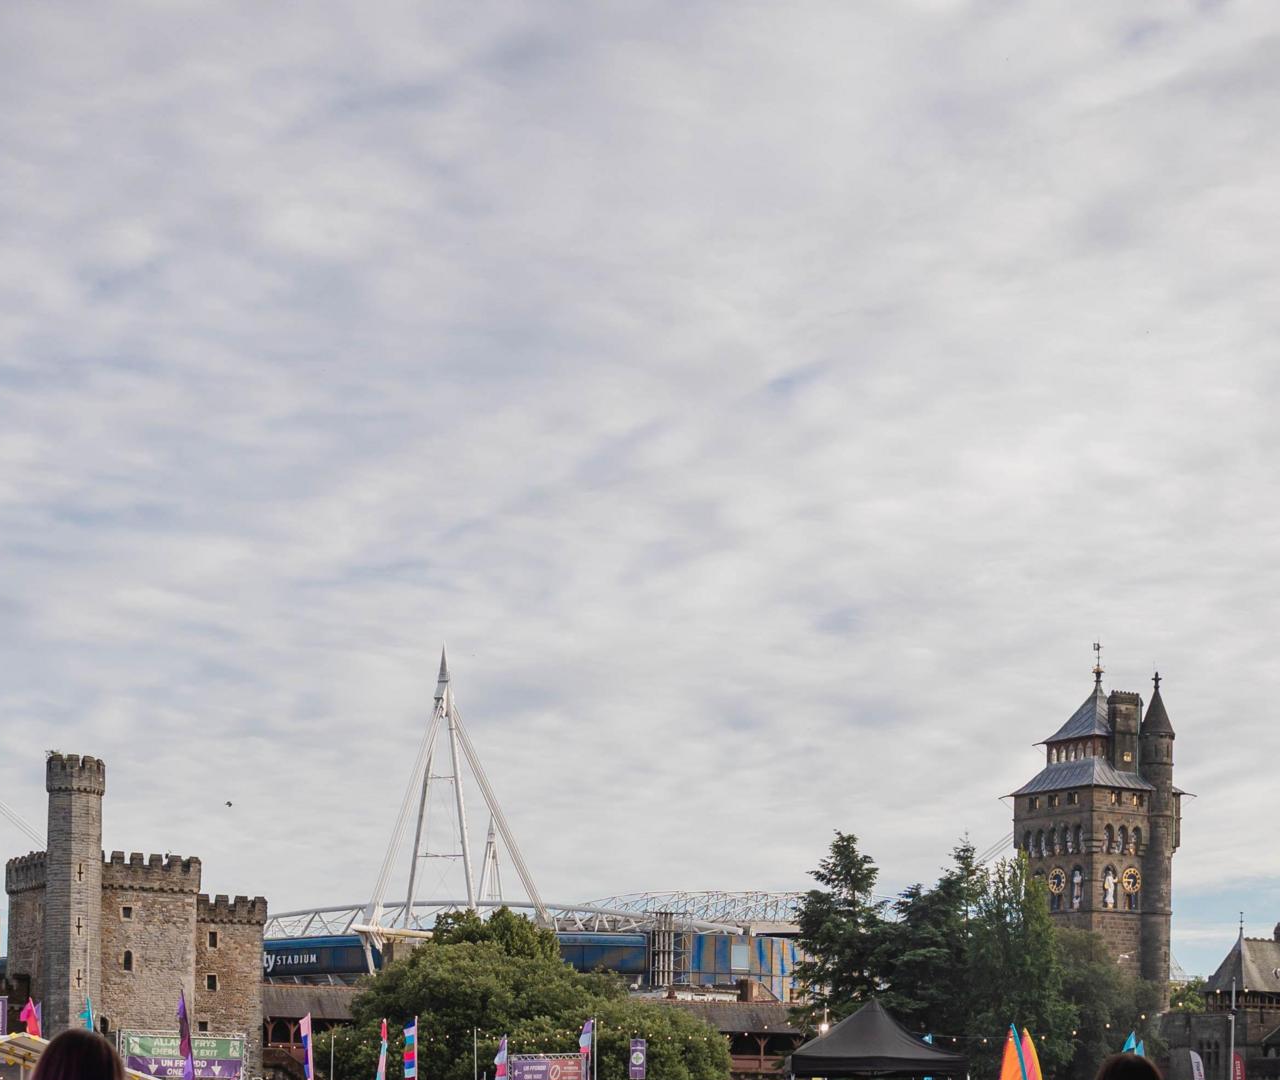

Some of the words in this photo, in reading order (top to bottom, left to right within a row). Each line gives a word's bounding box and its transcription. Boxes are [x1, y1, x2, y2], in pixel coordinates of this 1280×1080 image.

[276, 954, 317, 965] STADIUM
[200, 1049, 218, 1057] EXIT
[161, 1060, 172, 1068] UN
[166, 1068, 184, 1076] ONE
